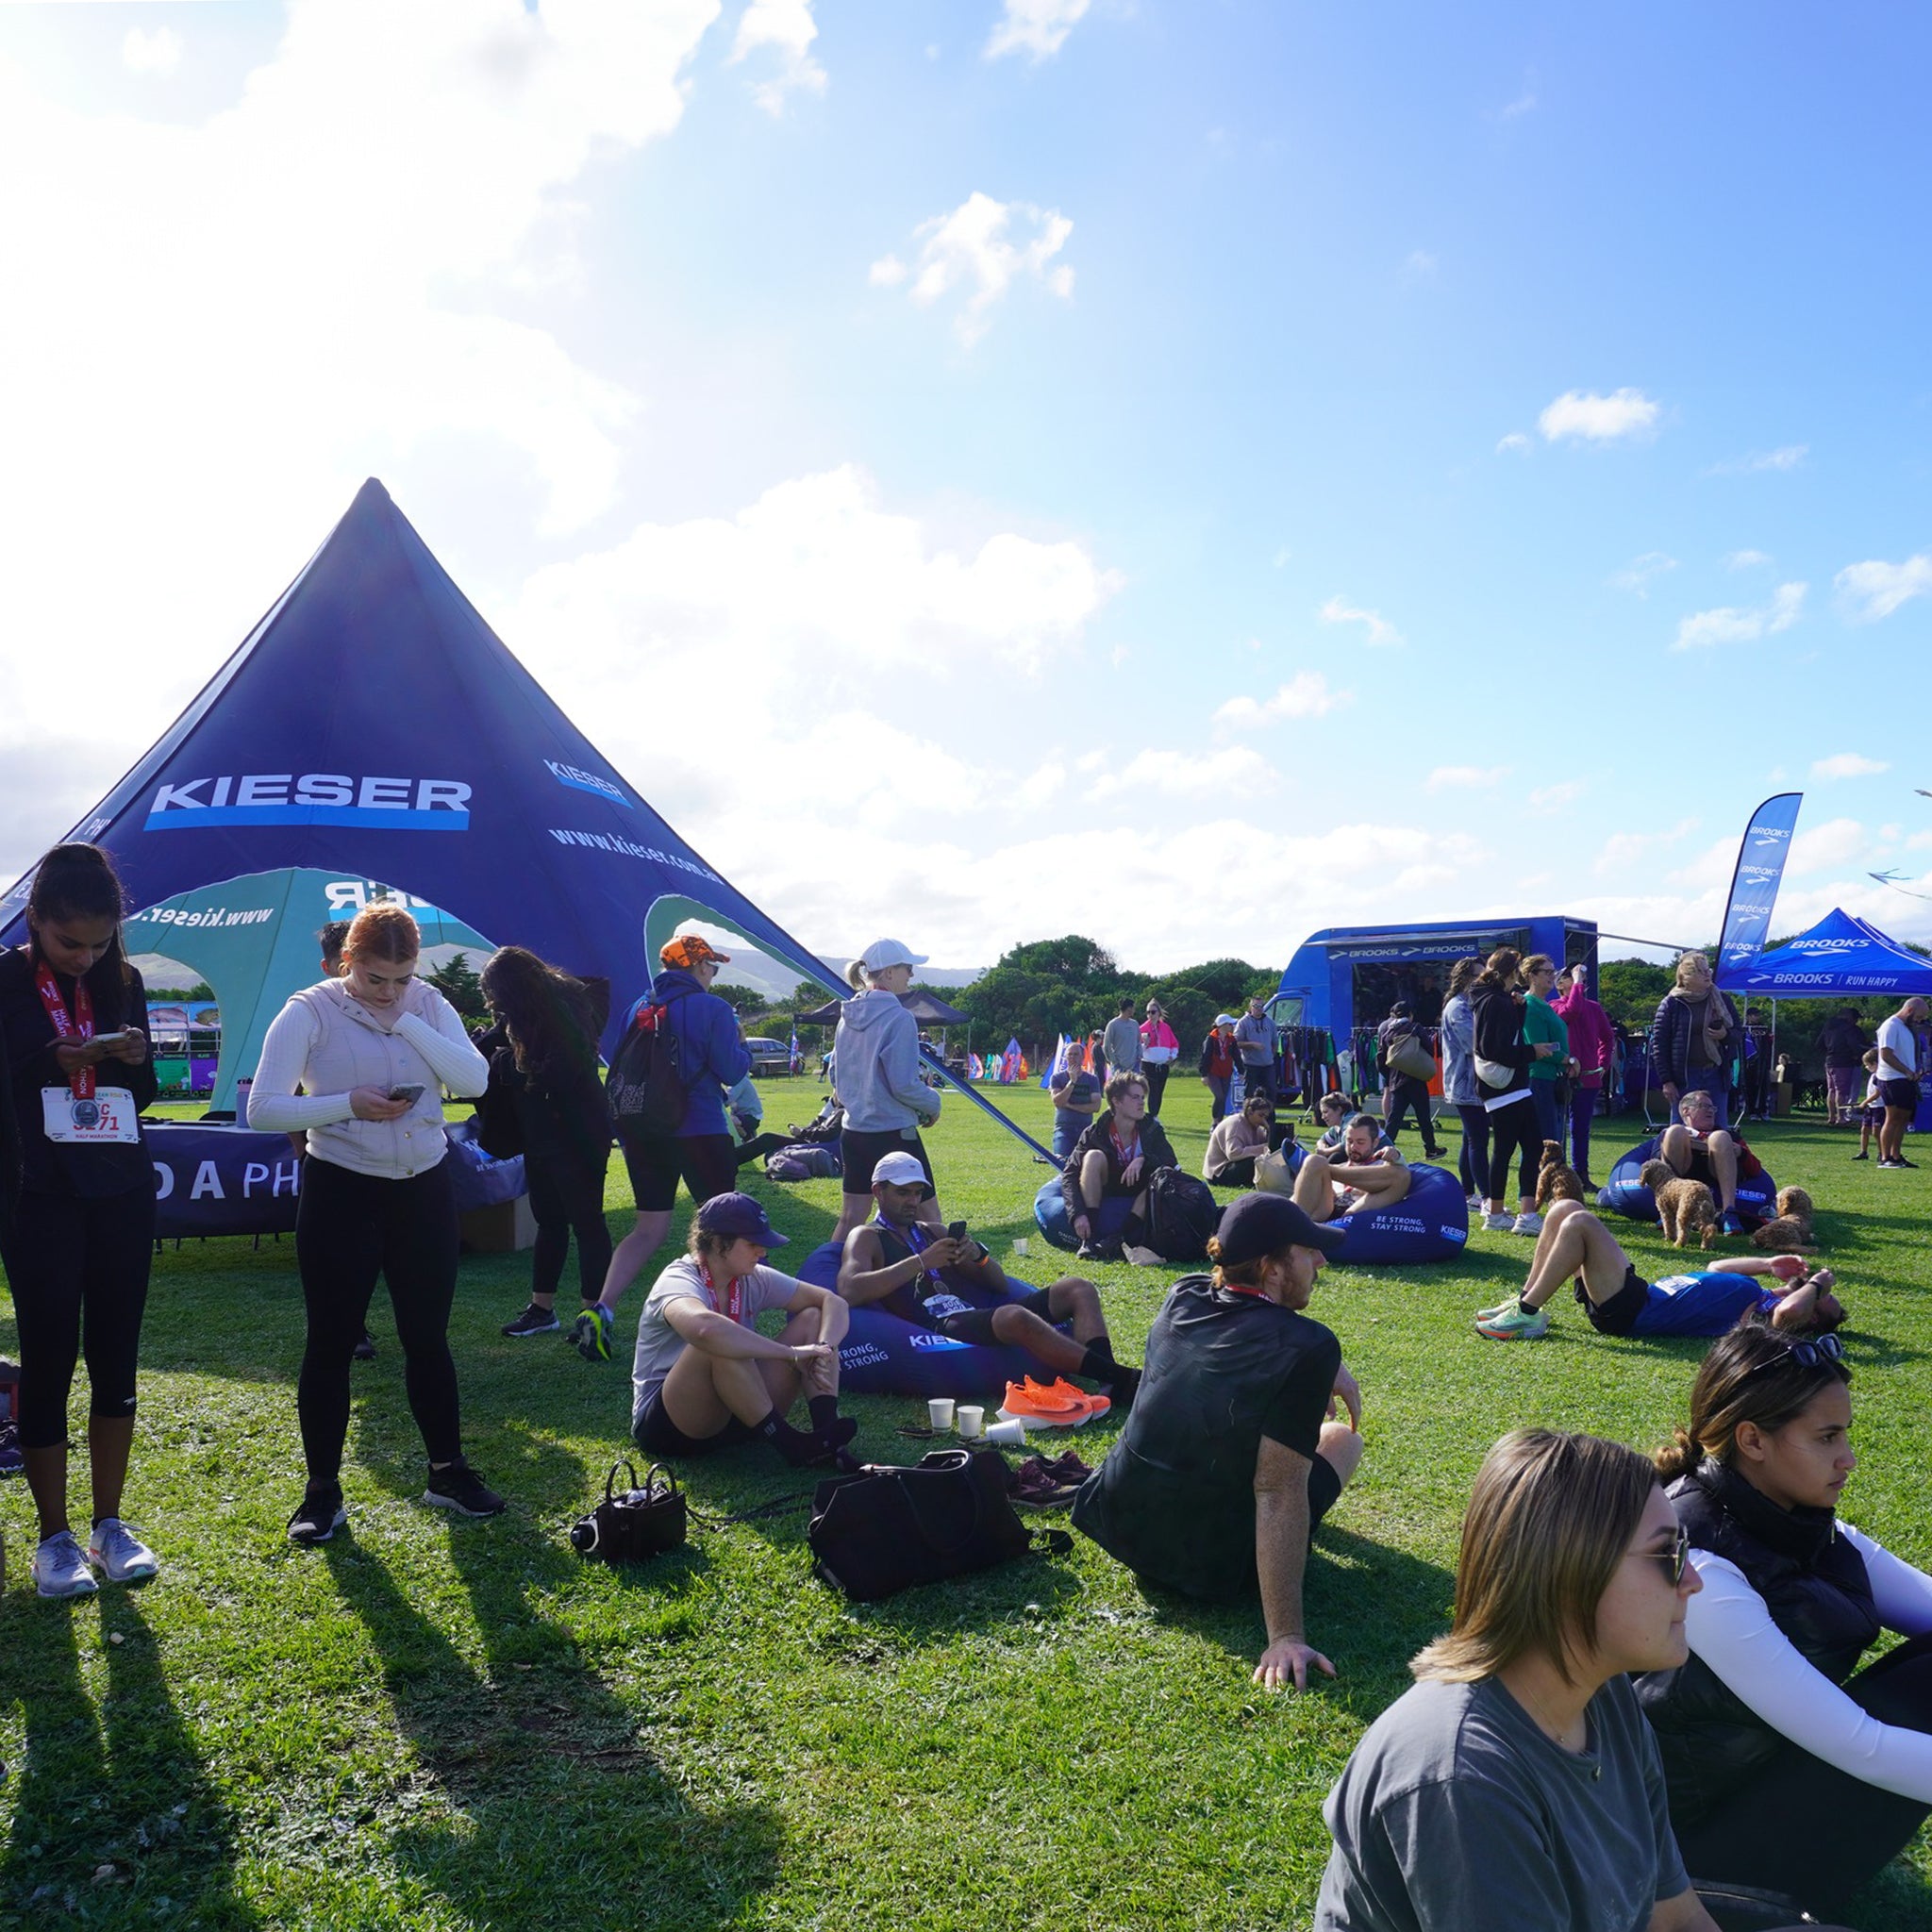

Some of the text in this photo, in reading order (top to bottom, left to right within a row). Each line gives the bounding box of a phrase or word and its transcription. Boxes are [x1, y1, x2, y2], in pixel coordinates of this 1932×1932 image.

[543, 758, 626, 801] KIESER
[150, 774, 473, 812] KIESER
[1750, 825, 1790, 838] BROOKS
[1740, 865, 1780, 876] BROOKS
[1732, 904, 1772, 914] BROOKS
[1724, 941, 1761, 952] BROOKS
[1790, 939, 1872, 949] BROOKS
[1349, 944, 1475, 958] BROOKS BROOKS
[1774, 974, 1898, 987] BROOKS RUN HAPPY
[74, 1116, 120, 1130] 71
[1389, 1216, 1424, 1226] STRONG,
[1371, 1222, 1426, 1234] STAY STRONG
[1440, 1224, 1467, 1239] KIESER
[839, 1342, 879, 1360] TRONG,
[844, 1350, 890, 1371] STRONG
